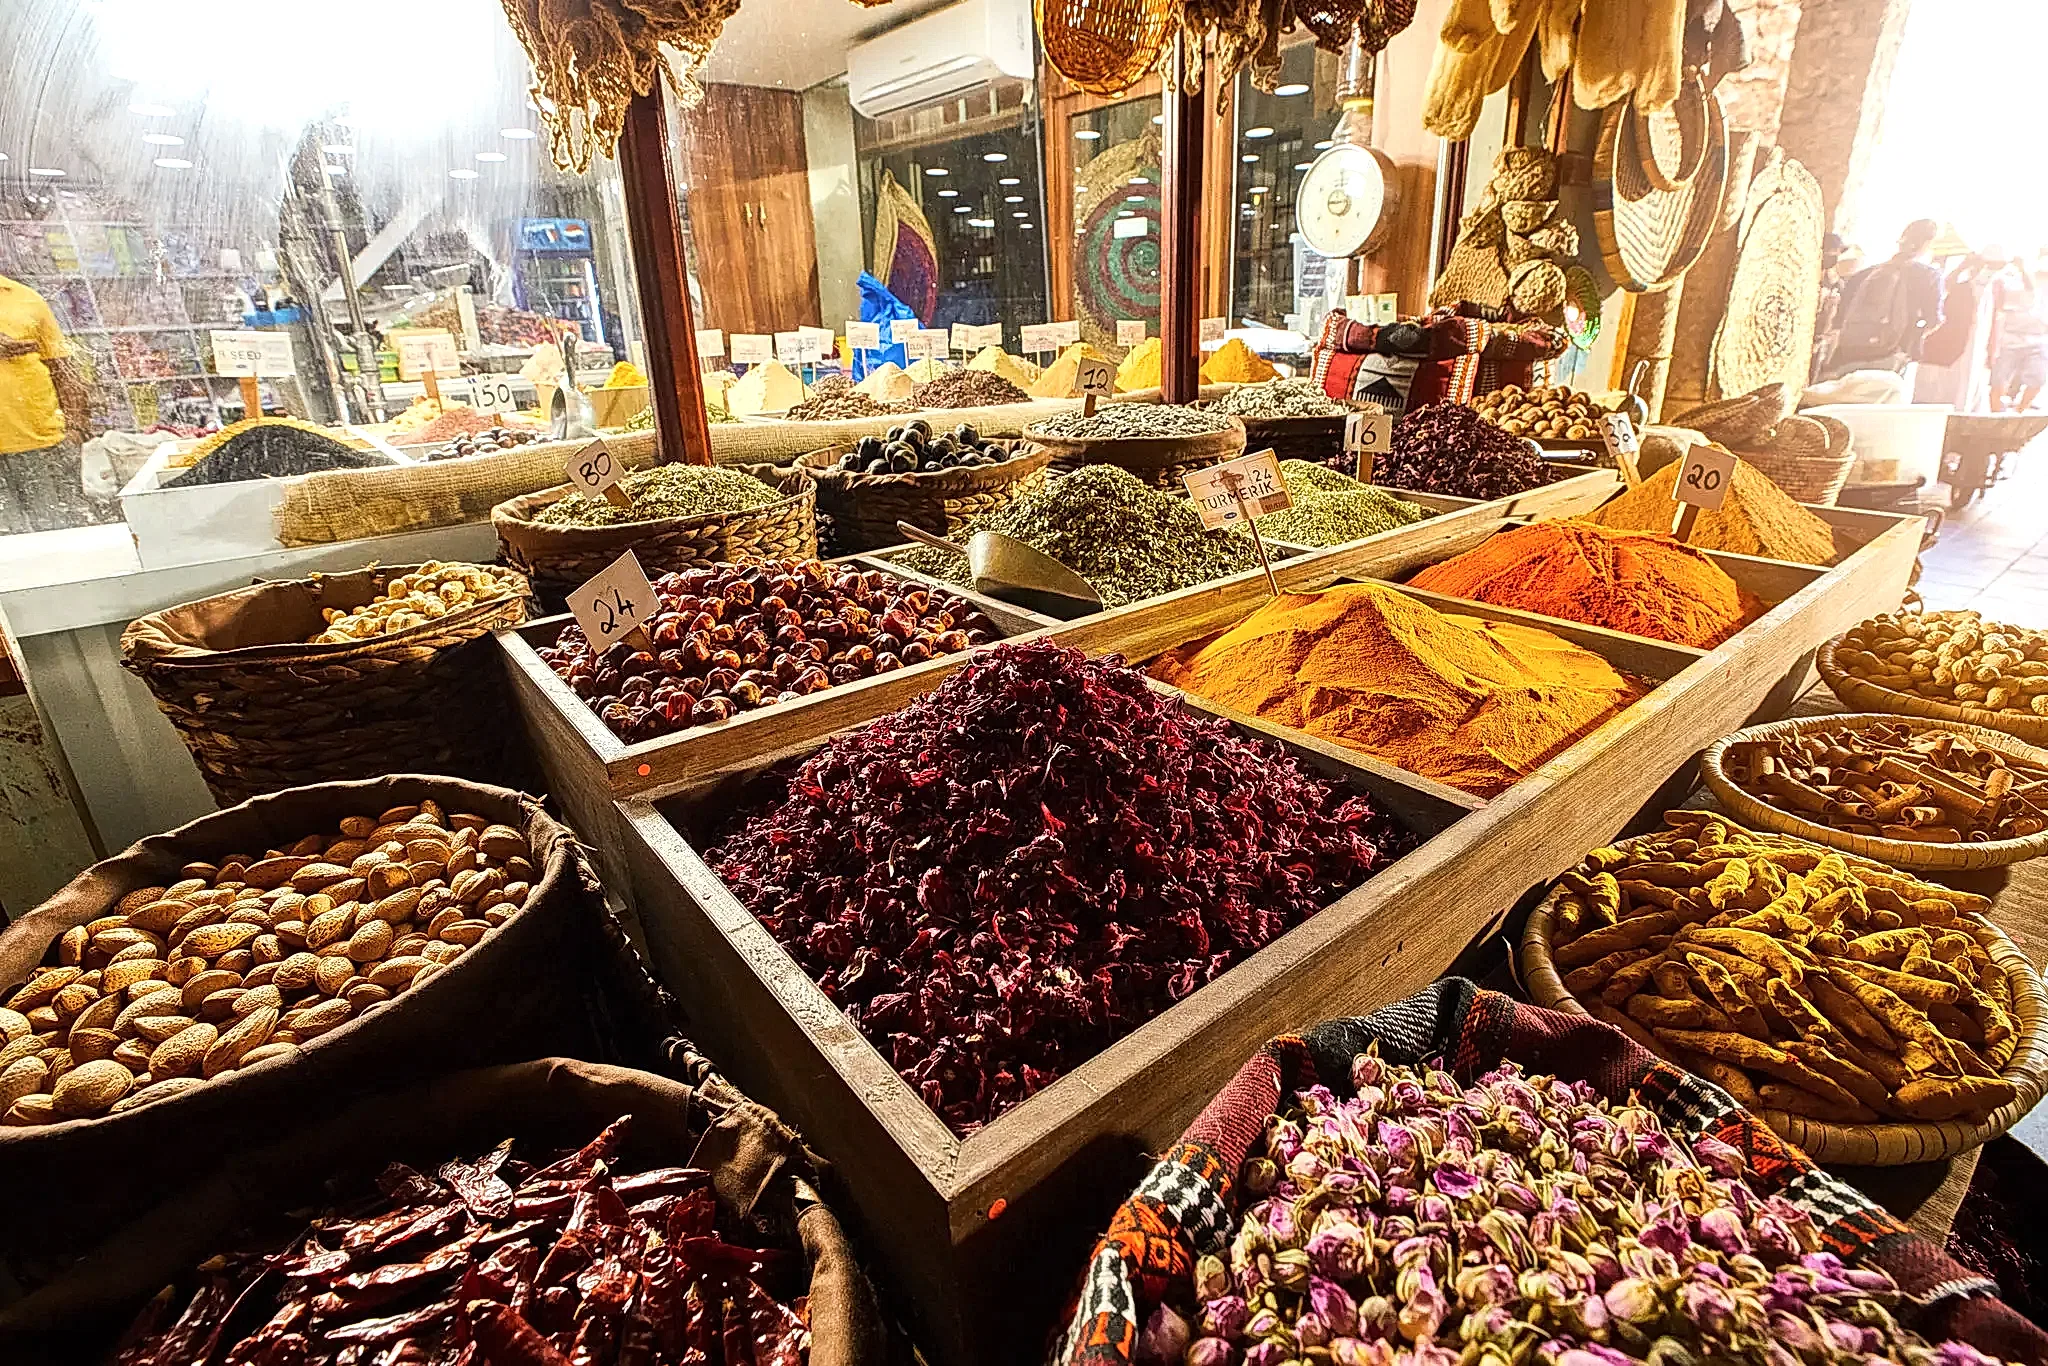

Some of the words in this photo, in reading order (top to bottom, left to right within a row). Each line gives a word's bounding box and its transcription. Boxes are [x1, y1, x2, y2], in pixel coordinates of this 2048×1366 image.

[1084, 367, 1109, 391] 12
[472, 383, 510, 408] 150
[1351, 420, 1377, 446] 16
[579, 451, 612, 487] 80
[1252, 467, 1273, 482] 24
[1686, 463, 1721, 490] 20
[1200, 480, 1275, 511] TURMERIK
[593, 588, 636, 634] 24
